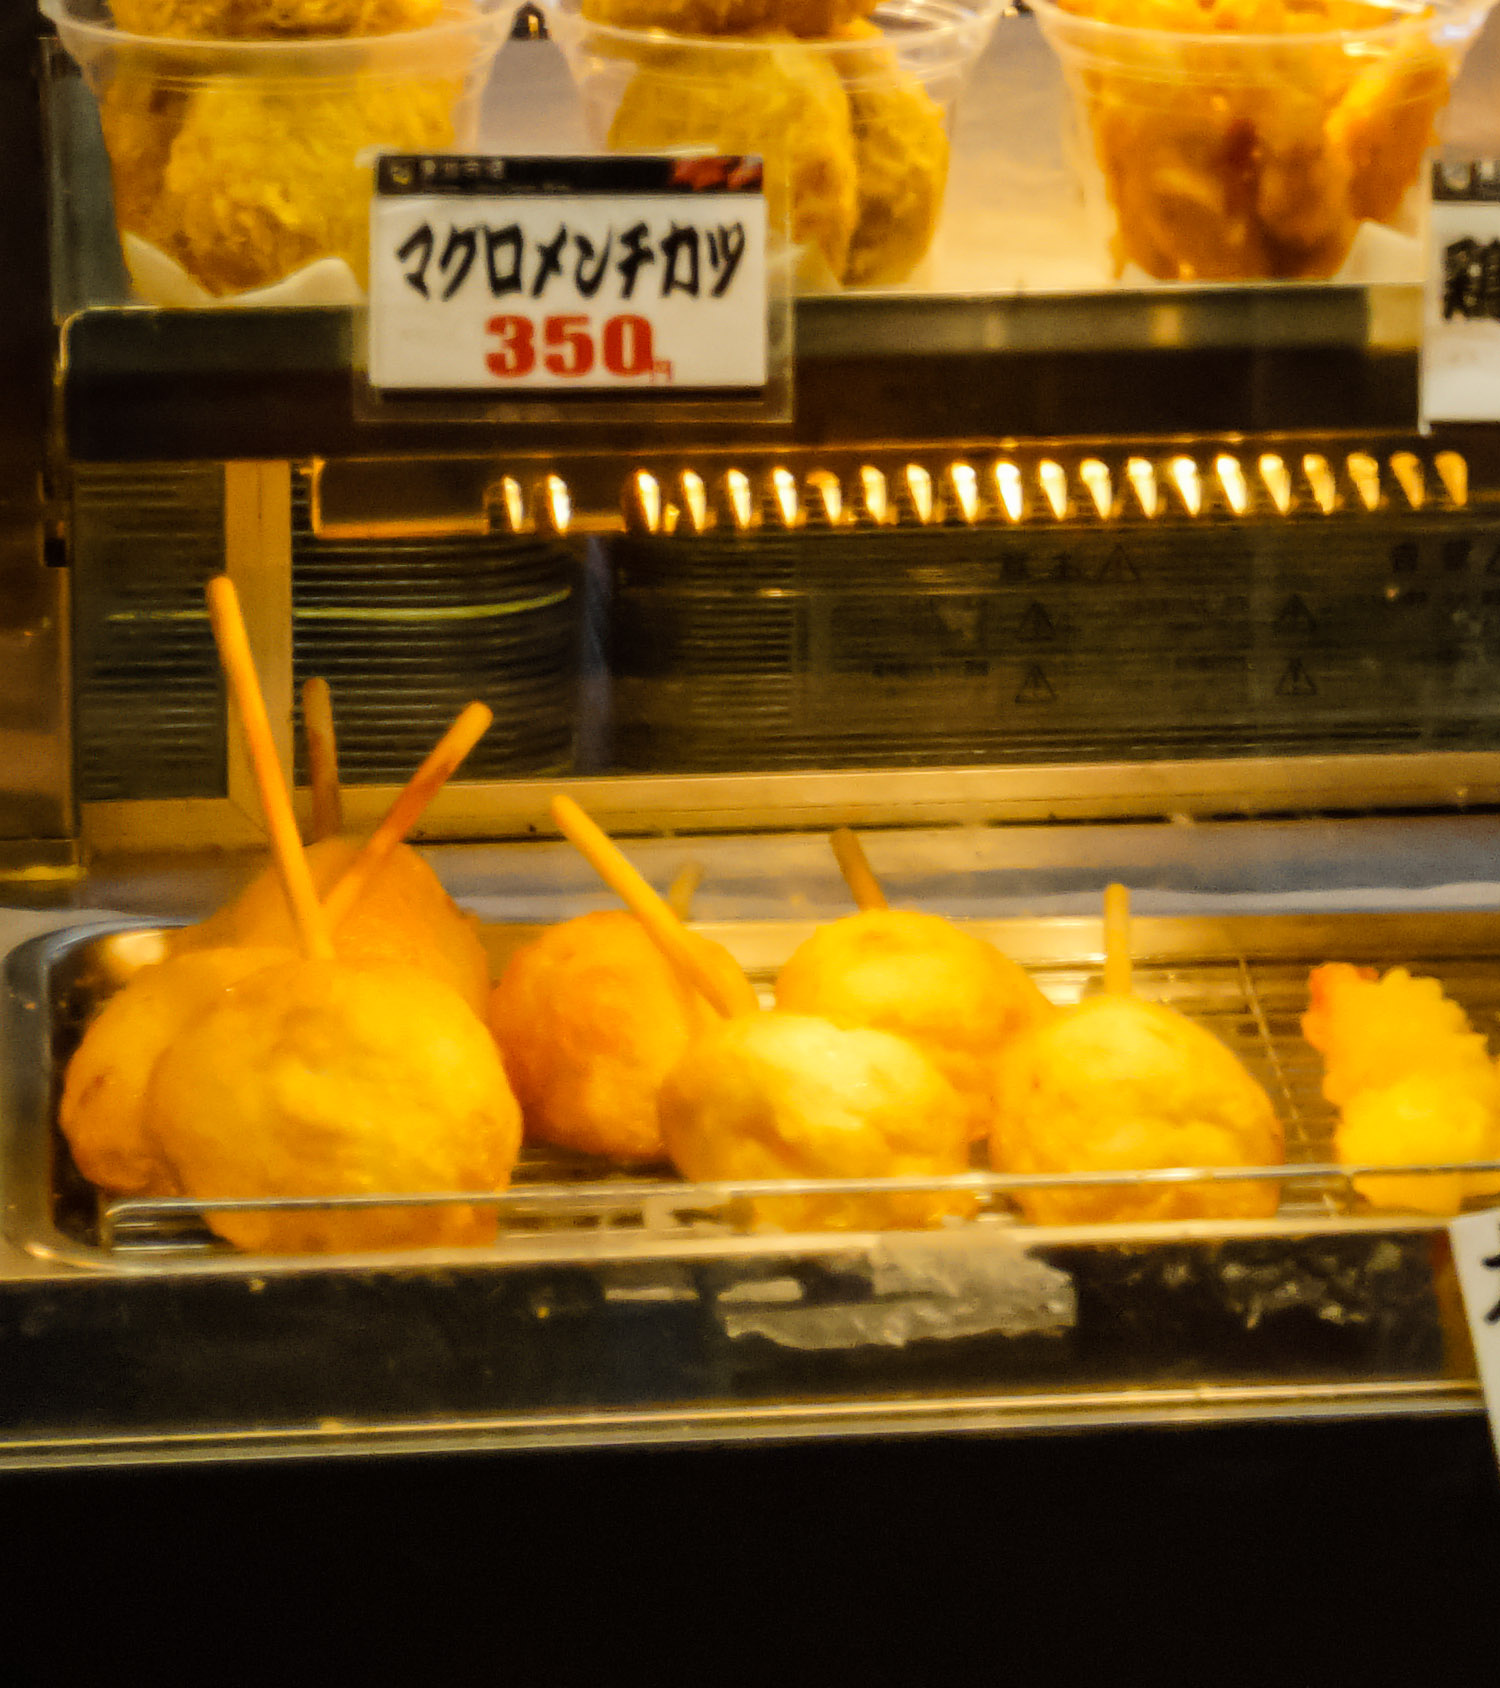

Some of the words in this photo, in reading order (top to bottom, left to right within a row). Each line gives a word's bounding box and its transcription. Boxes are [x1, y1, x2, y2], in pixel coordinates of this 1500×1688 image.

[396, 220, 747, 302] マグロメンチカツ
